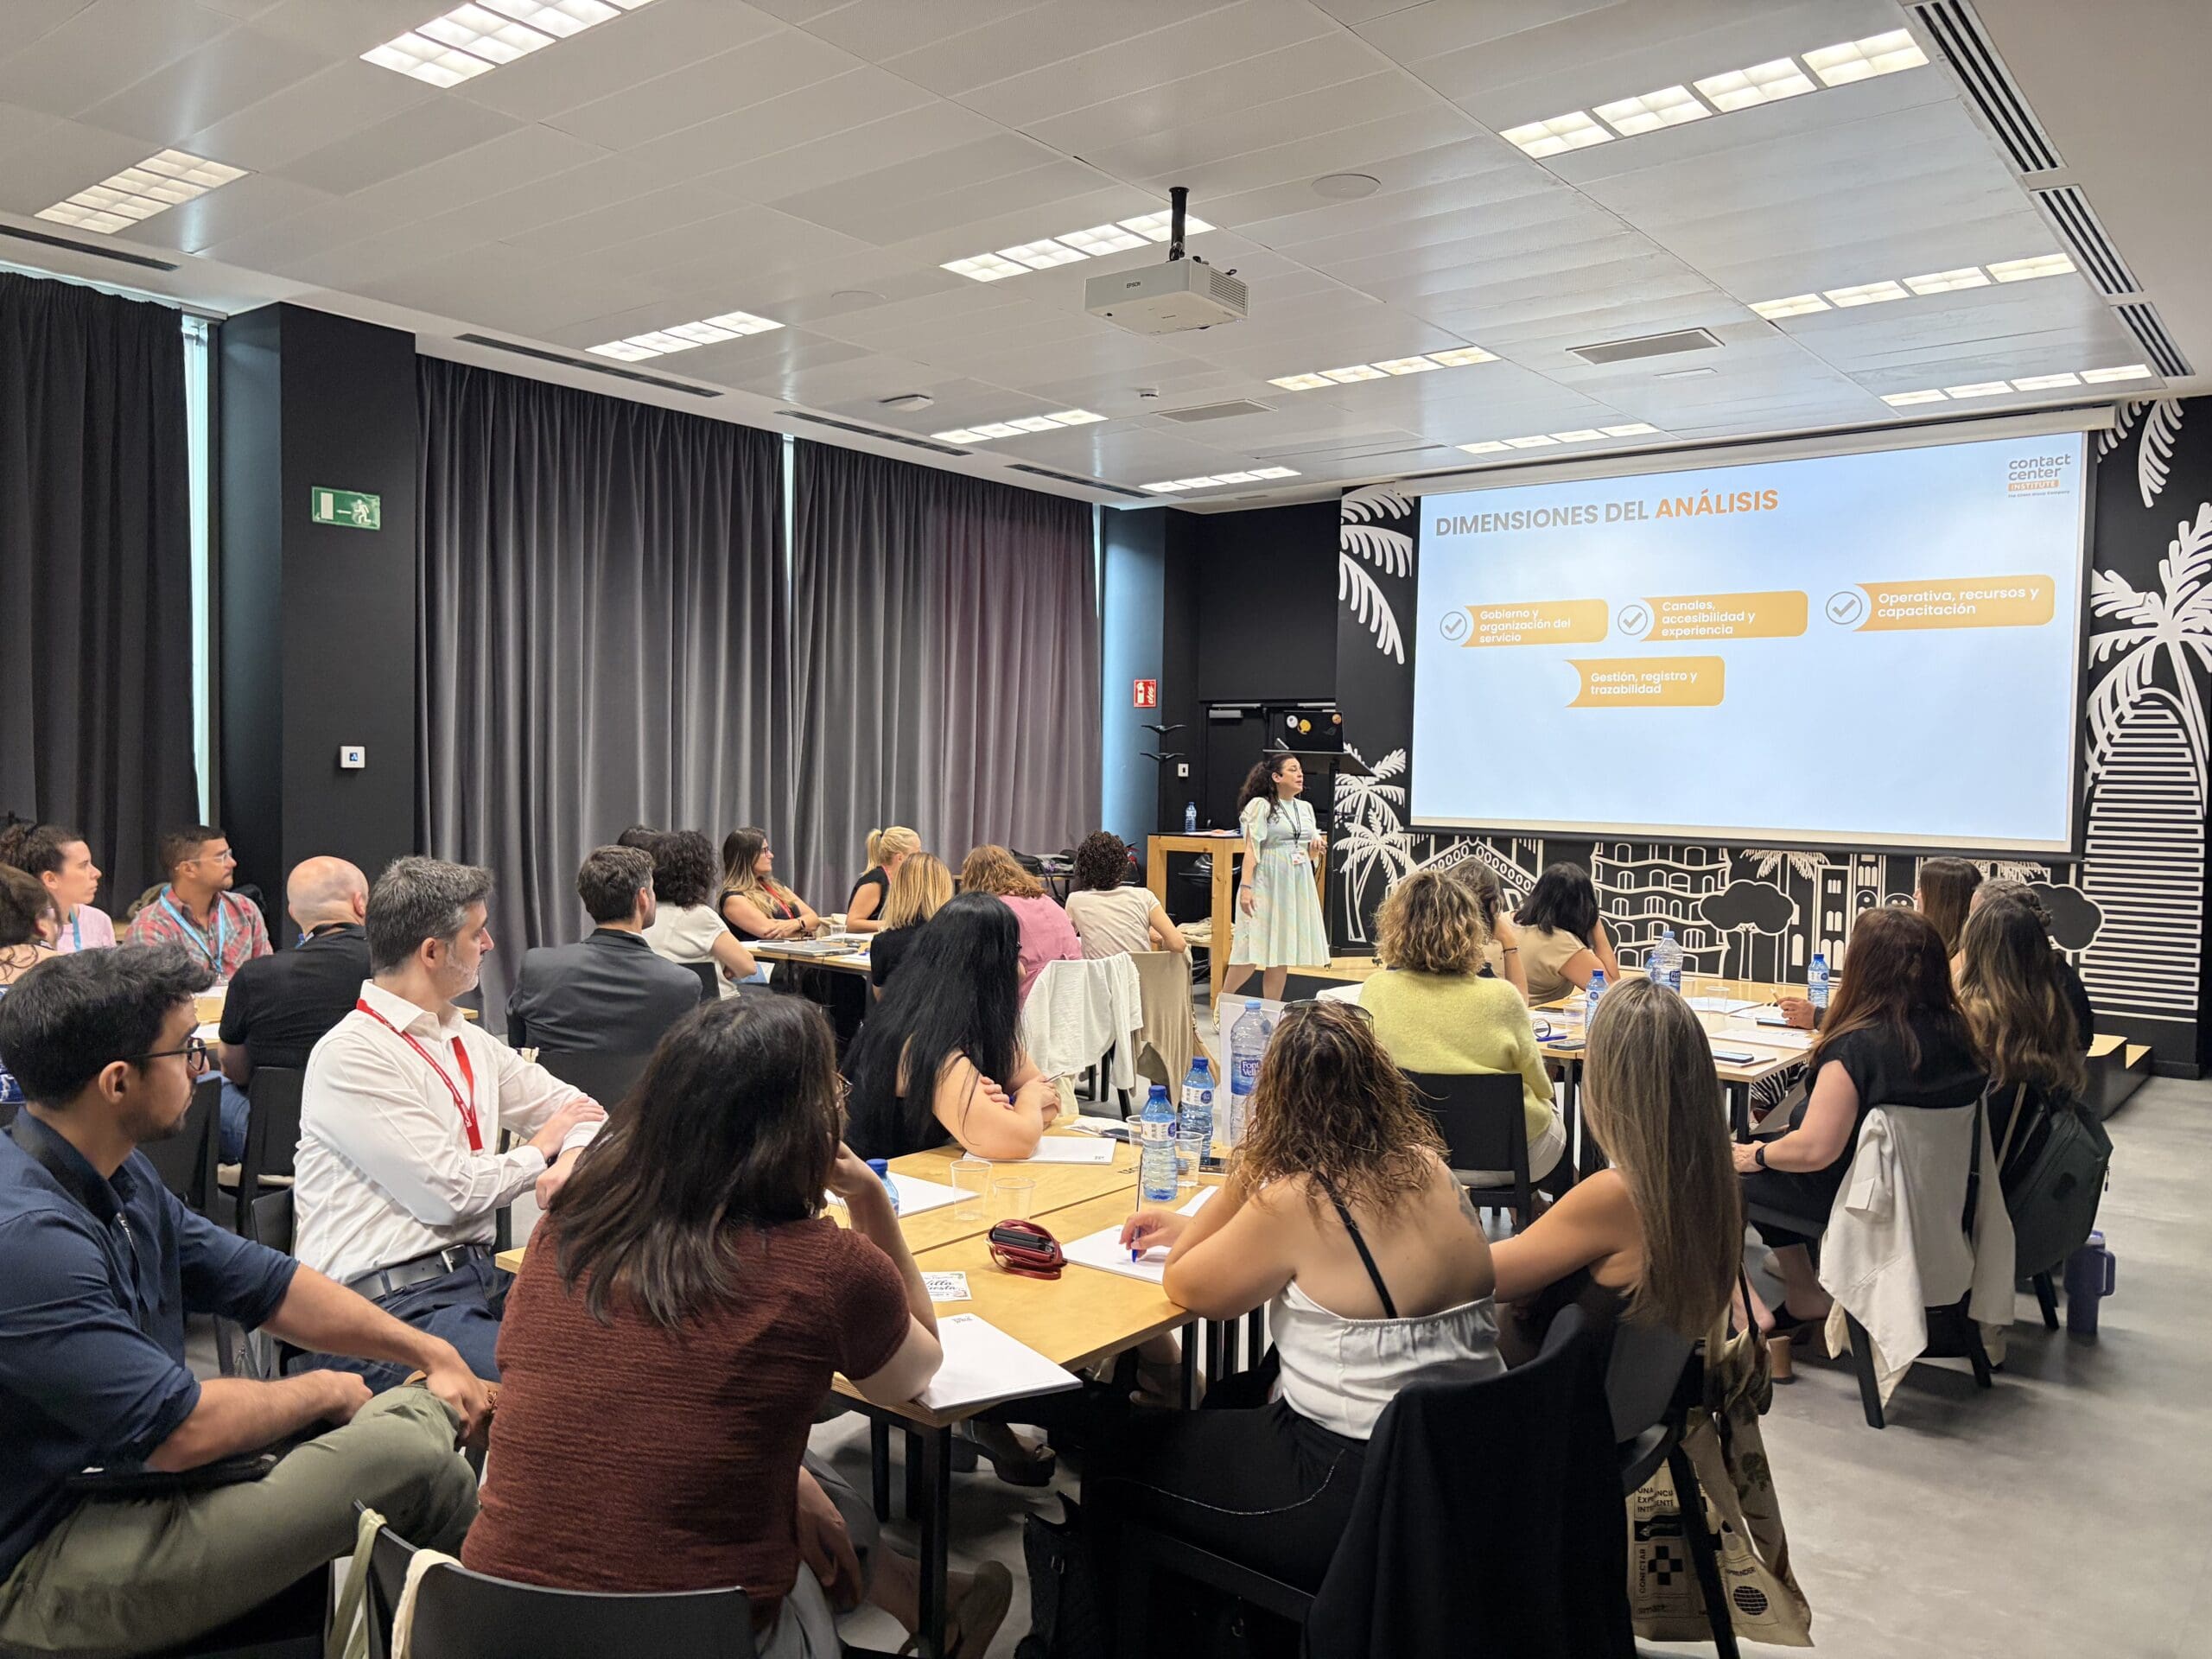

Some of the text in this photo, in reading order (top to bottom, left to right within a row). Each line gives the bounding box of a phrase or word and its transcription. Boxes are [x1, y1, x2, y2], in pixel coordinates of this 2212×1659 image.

[2008, 453, 2071, 470] contact
[2008, 467, 2062, 480] center
[2010, 480, 2056, 491] INSTITUTE
[1436, 488, 1778, 536] DIMENSIONES DEL ANÁLISIS
[1878, 588, 2040, 606] Operativa, recursos y
[1662, 600, 1716, 611] Canales,
[1877, 602, 1976, 620] capacitación
[1479, 608, 1539, 620] Gobierno y
[1662, 611, 1756, 624] accesibilidad y
[1479, 617, 1571, 634] organización del
[1662, 624, 1733, 639] experiencia
[1479, 632, 1522, 643] servicio
[1590, 670, 1698, 683] Gestión, registro y
[1590, 683, 1662, 695] trazabilidad
